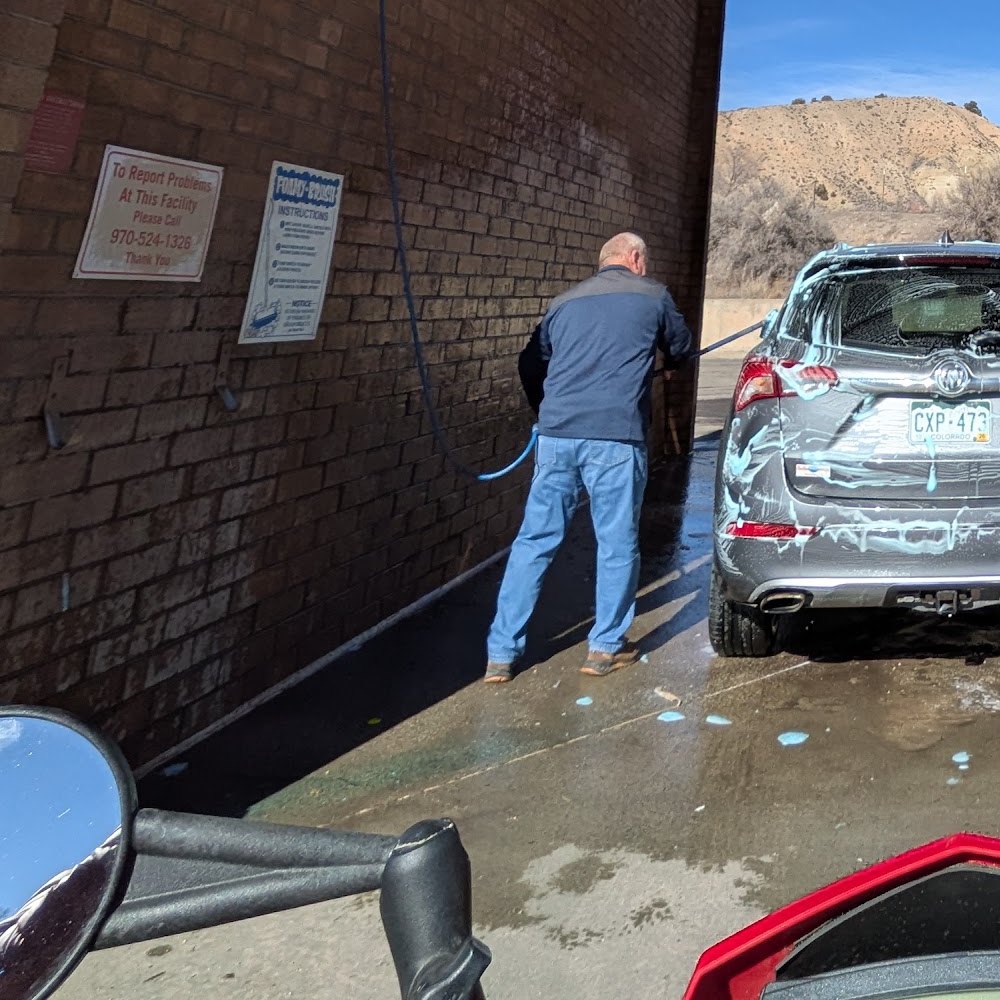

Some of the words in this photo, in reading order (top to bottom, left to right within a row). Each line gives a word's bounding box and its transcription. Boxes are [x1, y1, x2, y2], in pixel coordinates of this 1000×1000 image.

[113, 162, 126, 179] To
[128, 166, 165, 184] Report
[168, 172, 212, 193] Problems
[120, 188, 133, 203] At
[136, 190, 158, 206] This
[160, 194, 198, 214] Facility
[132, 210, 162, 225] Please
[165, 214, 182, 227] Call
[278, 206, 328, 222] INSTRUCTIONS
[110, 228, 192, 250] 970-524-1326
[126, 252, 152, 266] Thank
[155, 254, 170, 266] You
